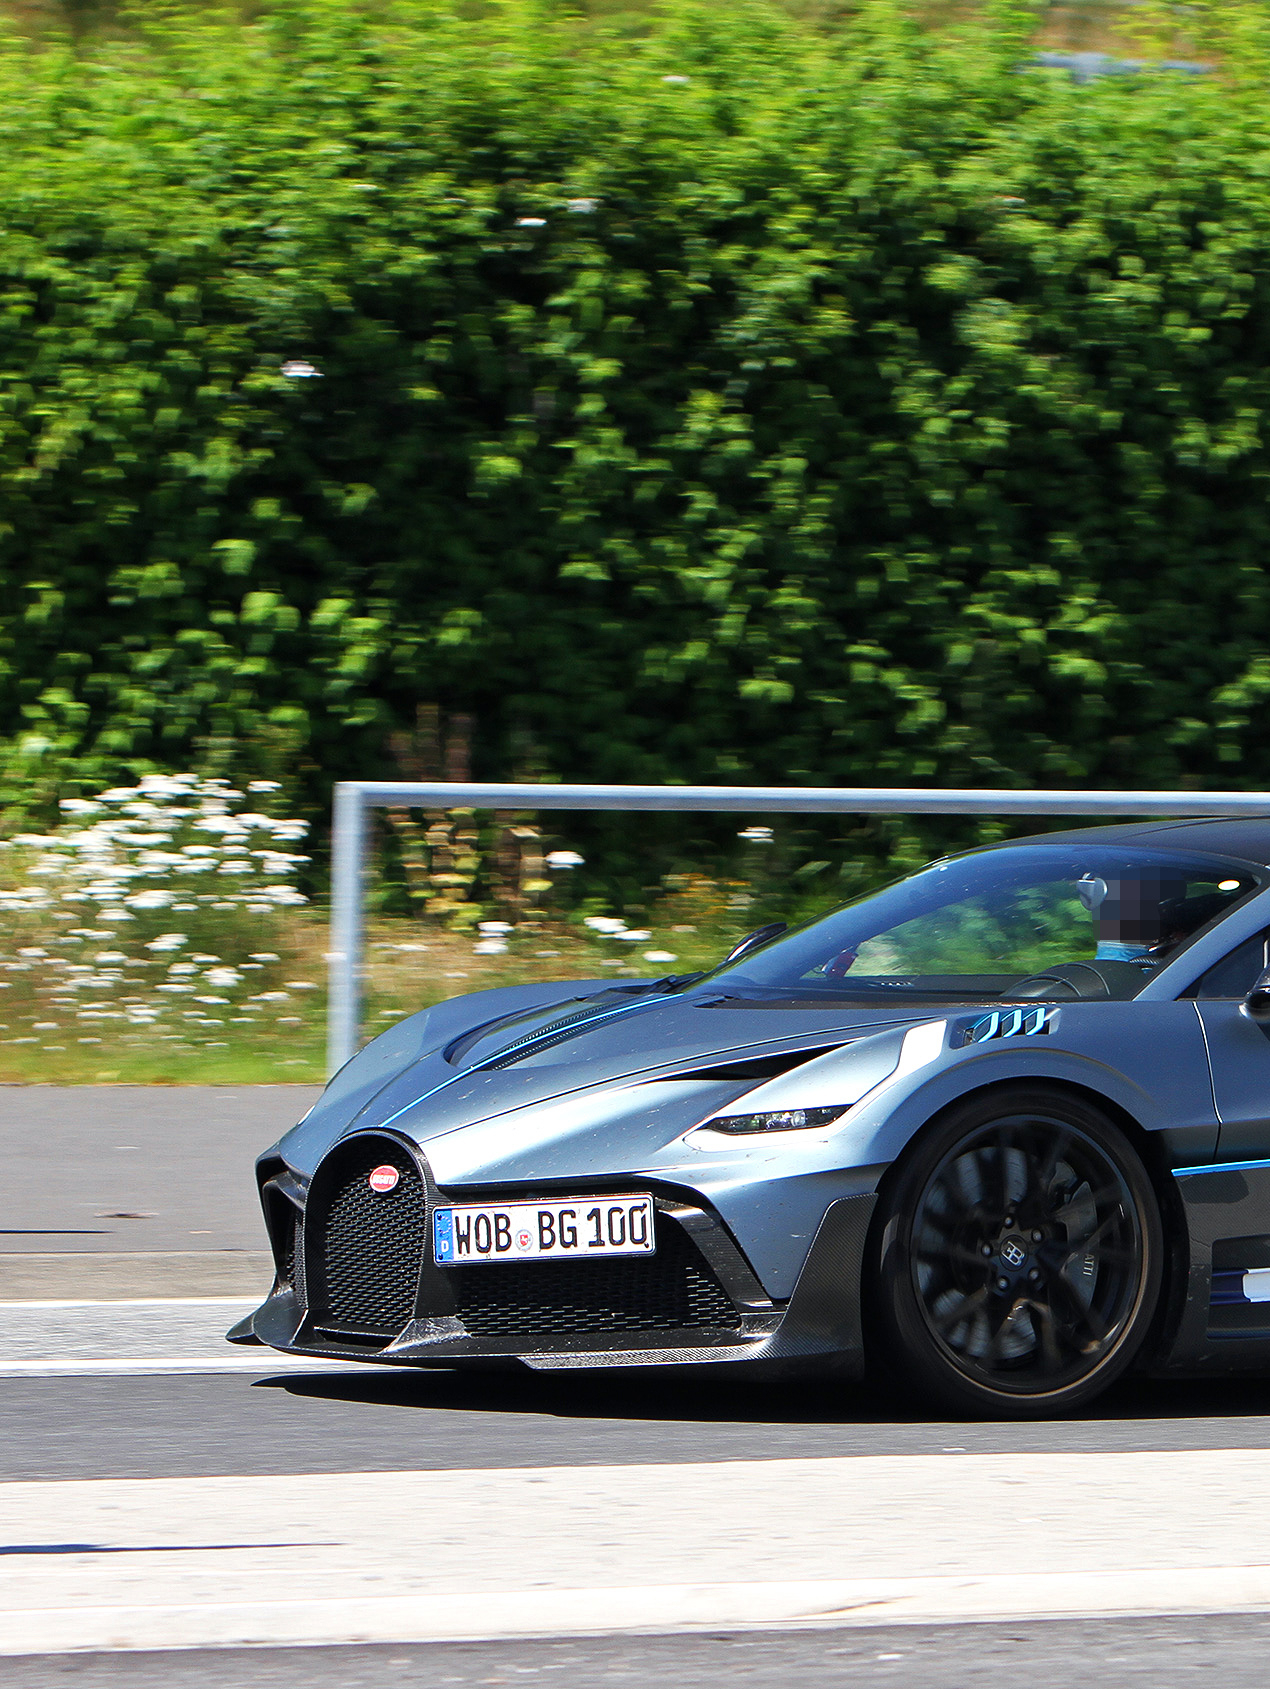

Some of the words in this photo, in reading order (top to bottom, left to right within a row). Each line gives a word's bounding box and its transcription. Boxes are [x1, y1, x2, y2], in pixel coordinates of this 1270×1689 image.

[441, 1240, 450, 1253] D
[455, 1213, 512, 1254] WOB
[537, 1209, 578, 1250] BG
[587, 1205, 648, 1247] 100
